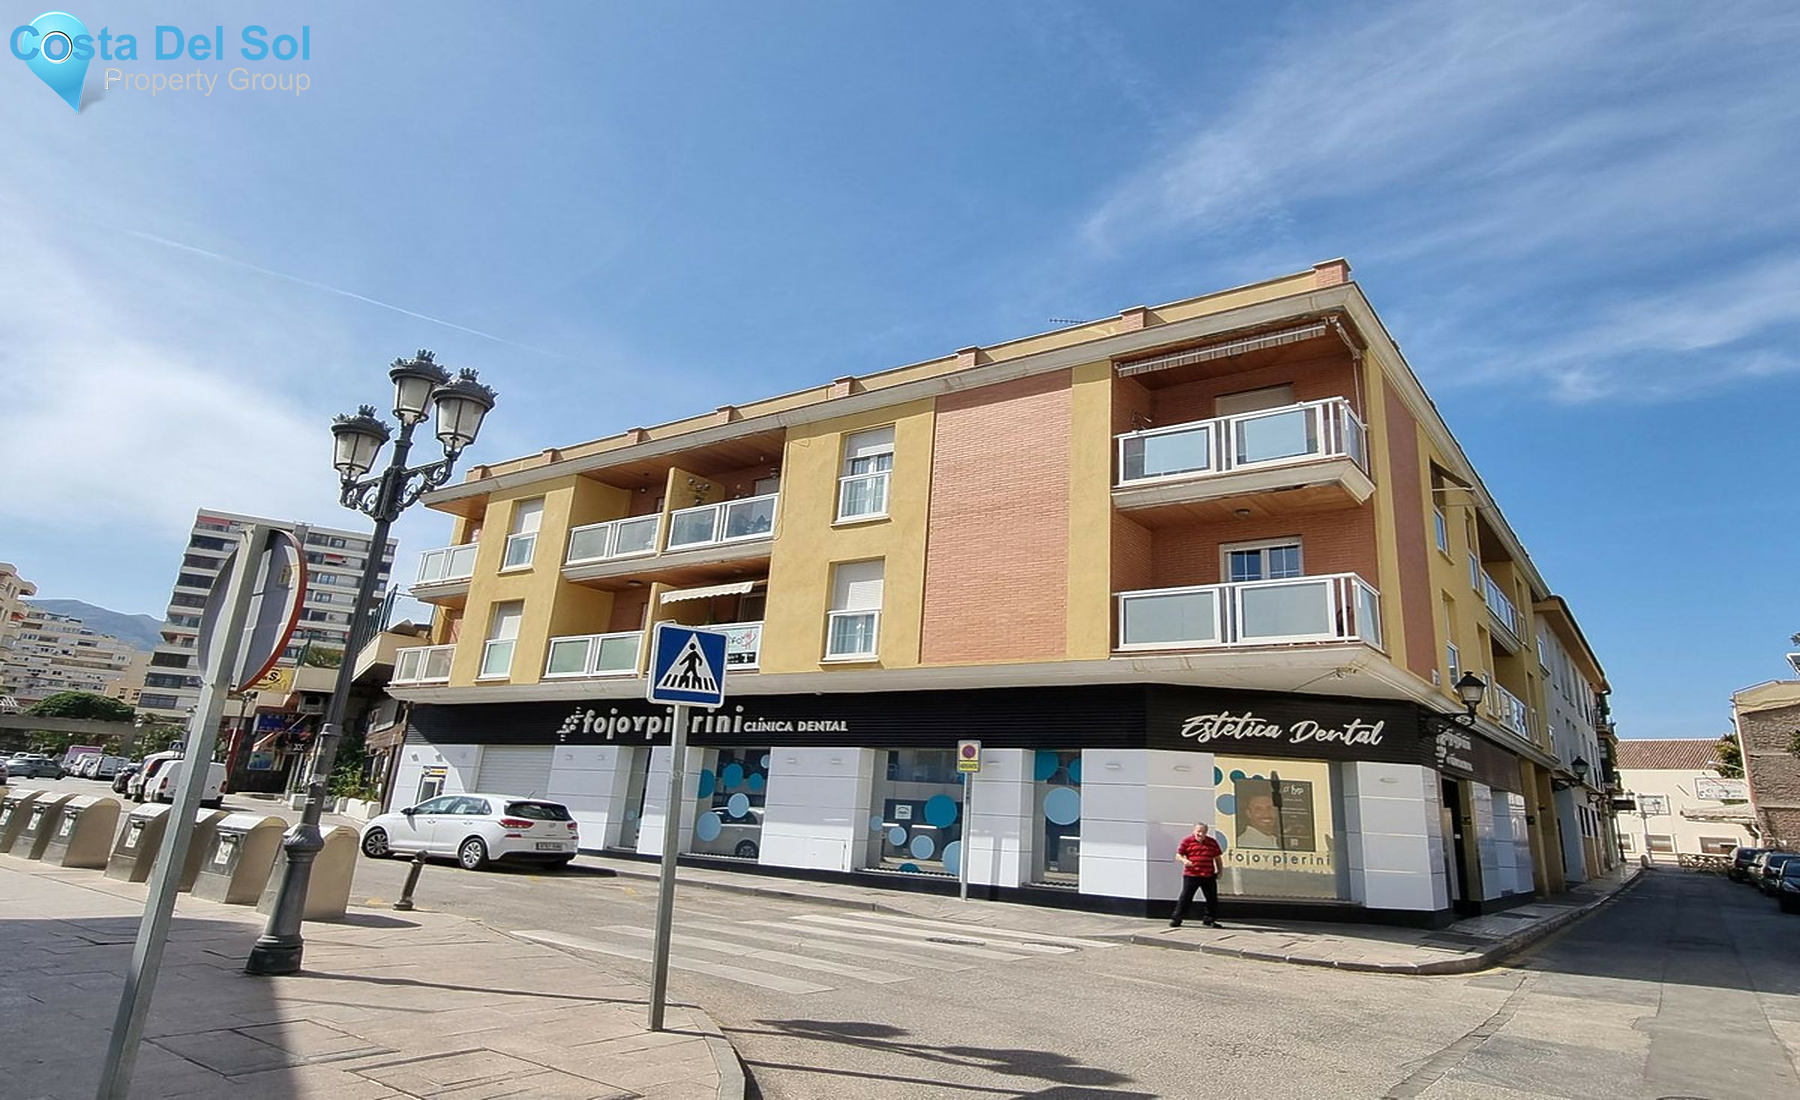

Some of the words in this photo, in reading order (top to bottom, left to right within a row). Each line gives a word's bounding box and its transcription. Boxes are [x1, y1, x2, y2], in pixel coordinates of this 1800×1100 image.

[583, 704, 744, 740] fojoypirini
[743, 717, 794, 732] CLÍNICA
[797, 720, 849, 732] DENTAL
[1289, 718, 1385, 746] Dental
